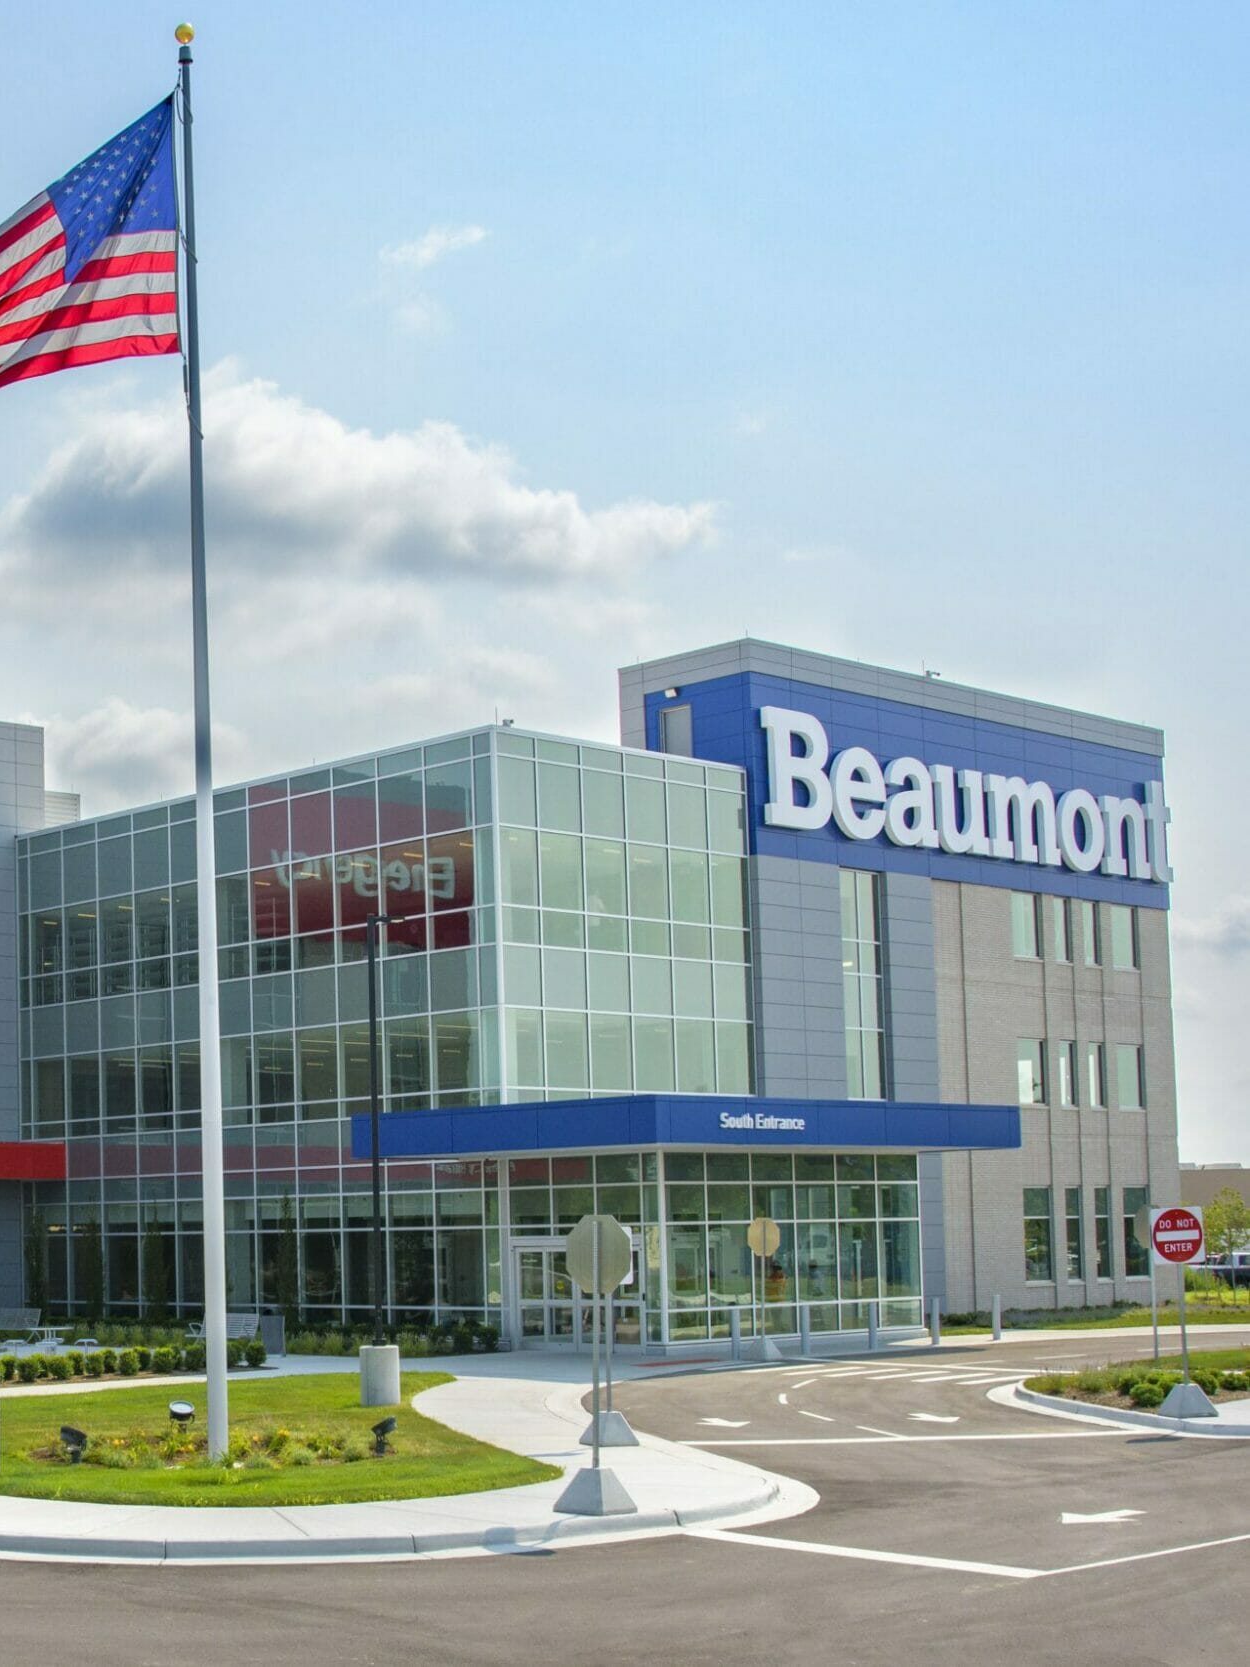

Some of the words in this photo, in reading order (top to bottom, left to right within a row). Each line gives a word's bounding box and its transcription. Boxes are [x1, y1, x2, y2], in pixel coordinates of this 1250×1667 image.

[760, 706, 1173, 883] Beaumont
[719, 1112, 754, 1129] South
[755, 1113, 805, 1130] Entrance
[1159, 1219, 1172, 1229] DO
[1176, 1218, 1195, 1228] NOT
[1164, 1242, 1193, 1253] ENTER
